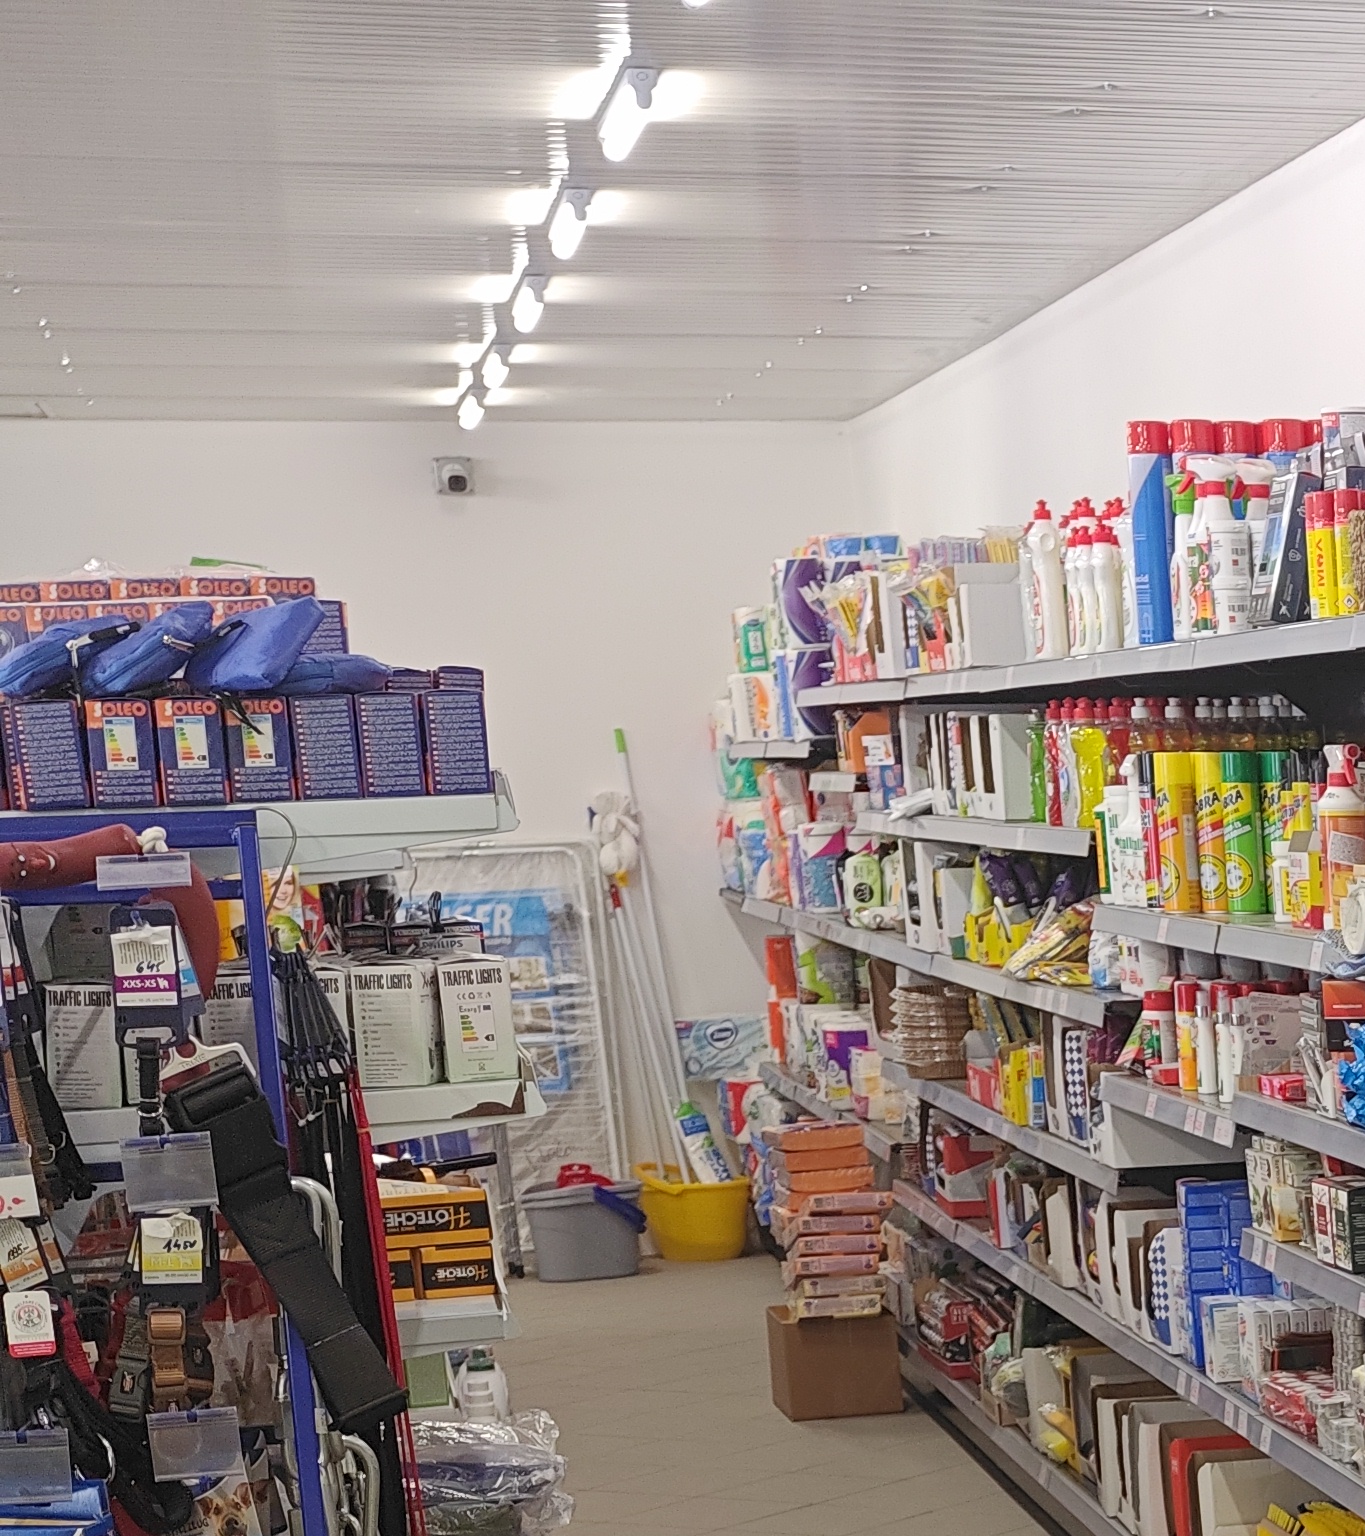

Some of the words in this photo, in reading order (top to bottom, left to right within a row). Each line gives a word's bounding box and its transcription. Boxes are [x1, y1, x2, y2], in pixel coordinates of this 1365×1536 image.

[49, 581, 105, 600] SOLEO
[119, 580, 177, 598] SOLEO
[189, 580, 246, 597] SOLEO
[257, 578, 315, 596] SOLEO
[94, 701, 147, 717] SOLEO
[164, 700, 217, 717] SOLEO
[421, 940, 463, 949] PHILIPS
[354, 974, 384, 990] TRAFFIC
[386, 973, 412, 990] LIGHTS
[442, 970, 473, 987] TRAFFIC
[475, 968, 502, 984] LIGHTS
[48, 990, 82, 1007] TRAFFIC
[83, 990, 111, 1007] LIGHTS
